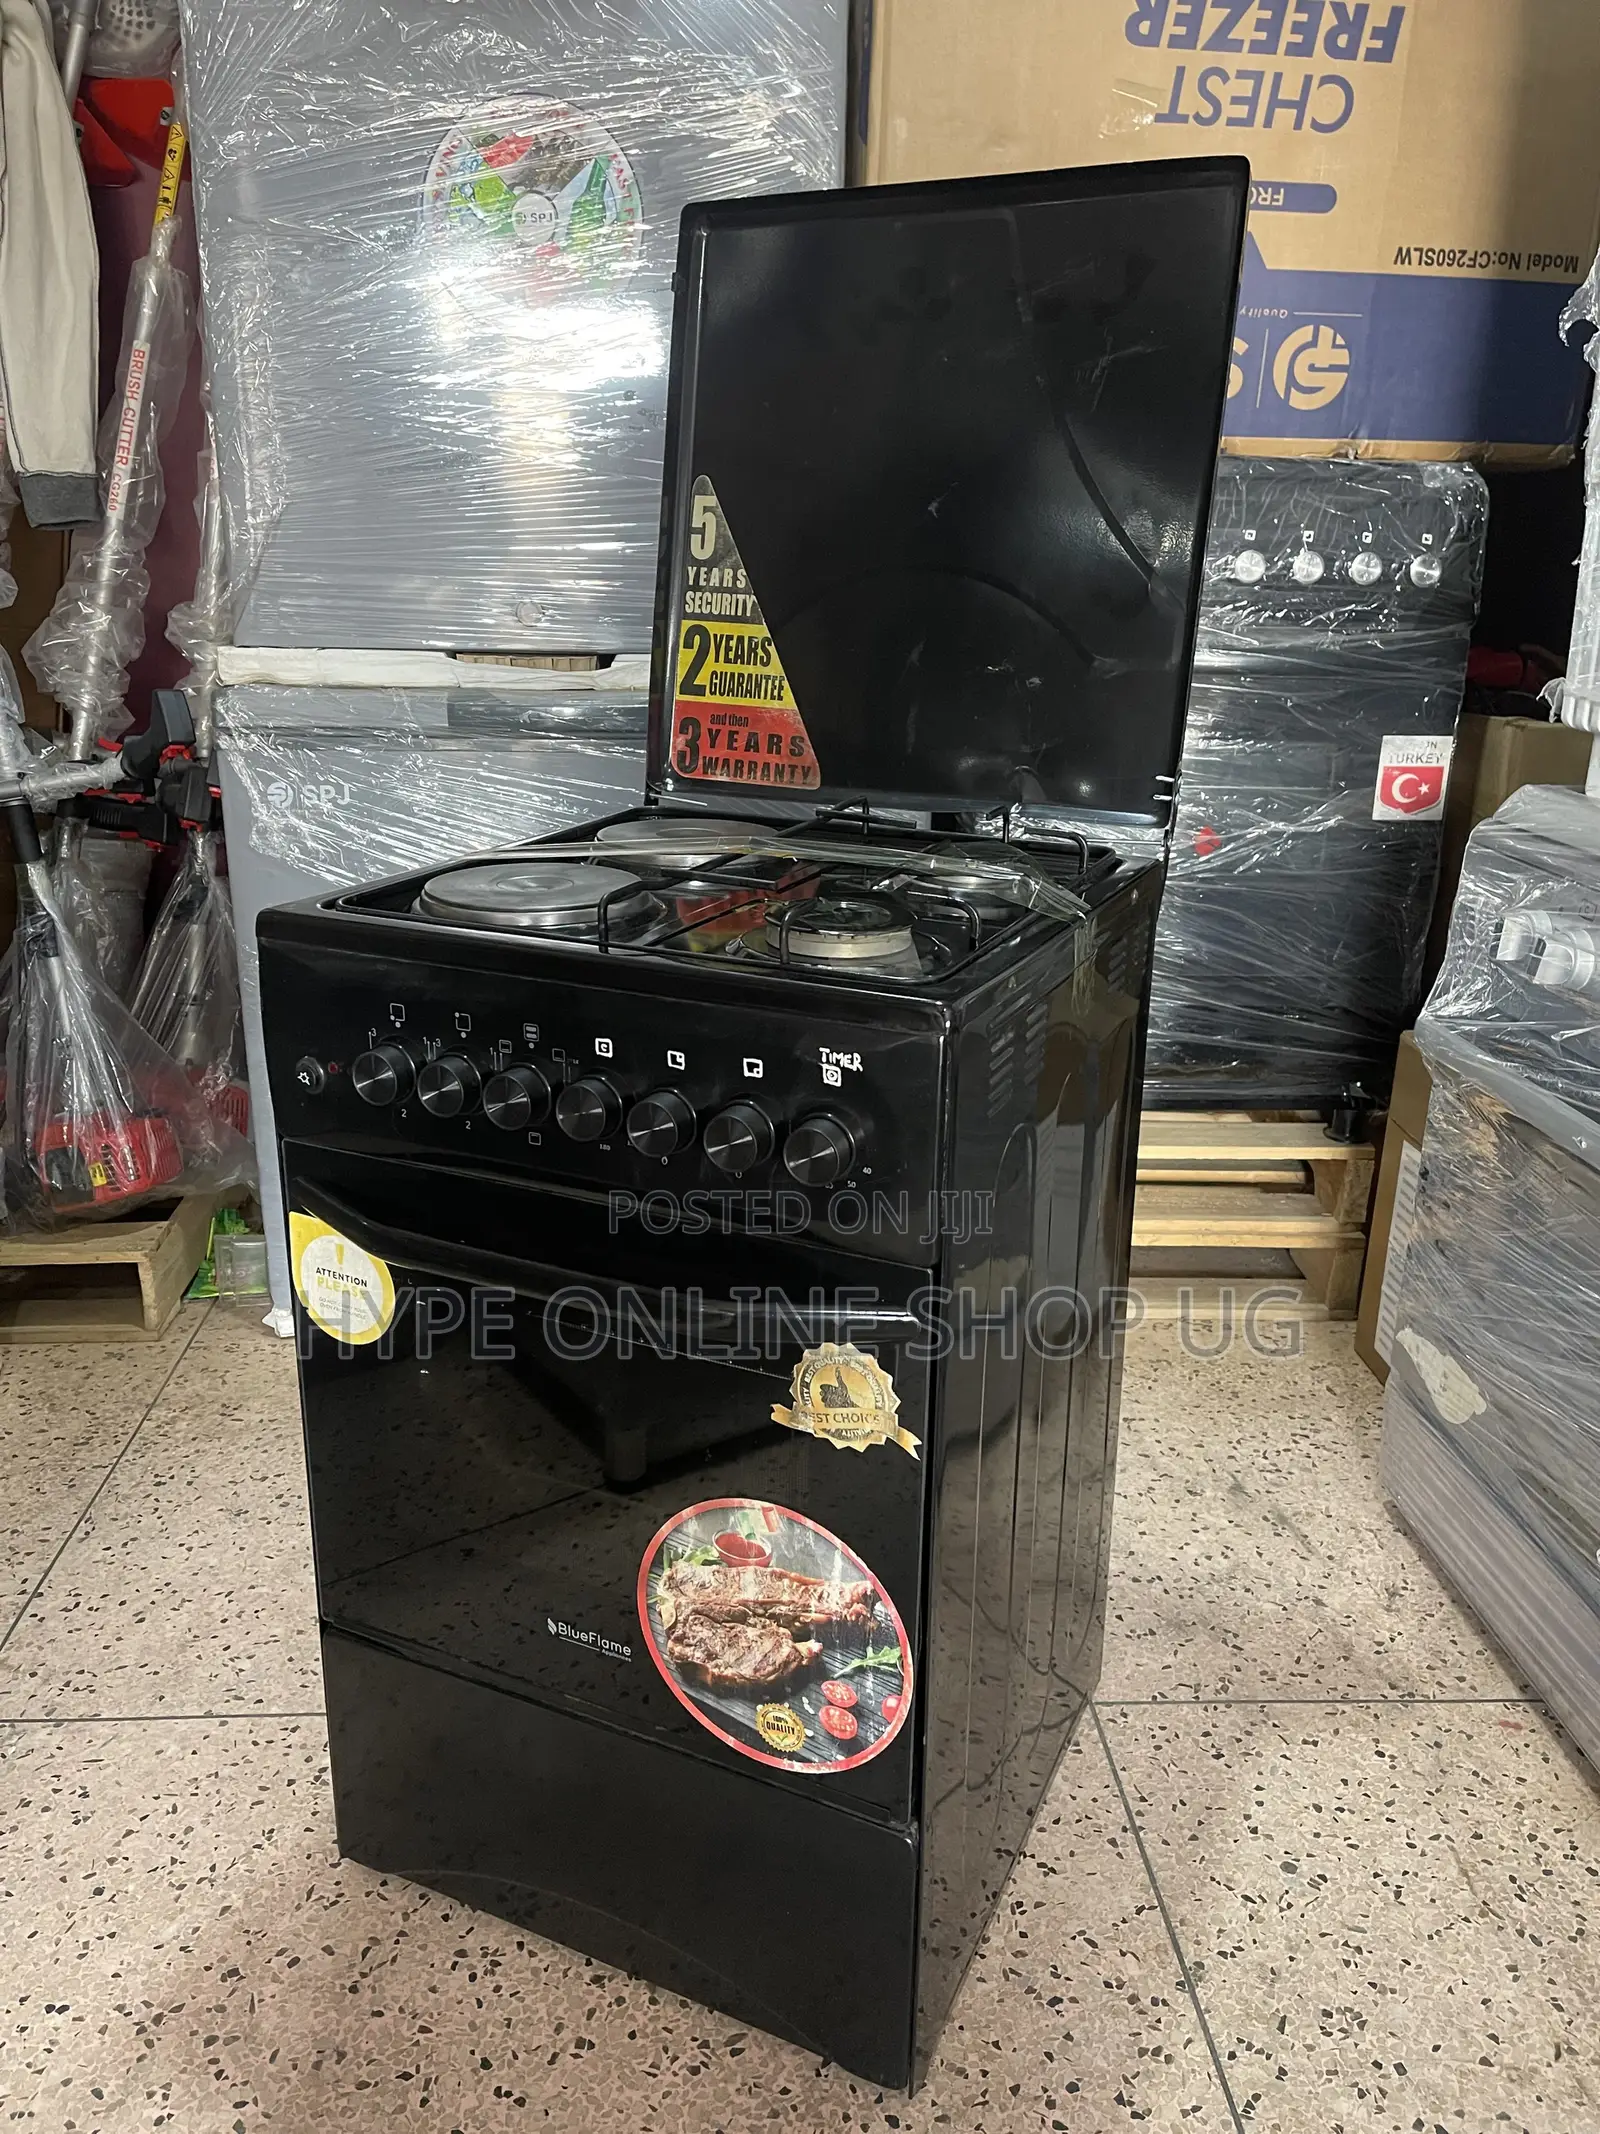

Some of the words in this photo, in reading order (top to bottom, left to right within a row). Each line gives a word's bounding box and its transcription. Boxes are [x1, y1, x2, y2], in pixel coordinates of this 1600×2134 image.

[1124, 0, 1406, 63] FREEZER
[1154, 66, 1355, 134] CHEST
[1393, 246, 1522, 272] No:CF260SLW
[1527, 252, 1579, 274] Model
[1239, 305, 1289, 320] Quality
[124, 348, 146, 401] BRUSH
[116, 407, 136, 467] CUTTER
[107, 472, 122, 512] CG260
[690, 494, 718, 561] 5
[687, 565, 747, 589] YEARS
[685, 590, 757, 617] SECURITY
[679, 623, 711, 698] 2
[713, 632, 773, 668] YEARS
[709, 670, 786, 702] GUARANTEE
[710, 712, 728, 726] and
[728, 713, 749, 728] then
[676, 716, 702, 774] 3
[707, 727, 806, 758] YEARS
[1388, 752, 1443, 764] TURKEY
[702, 755, 812, 785] WARRANTY
[302, 783, 350, 805] SPJ
[316, 1267, 368, 1288] ATTENTION
[318, 1276, 368, 1300] PLEASE
[558, 1622, 632, 1656] BlueFlame
[765, 1720, 795, 1735] QUALITY
